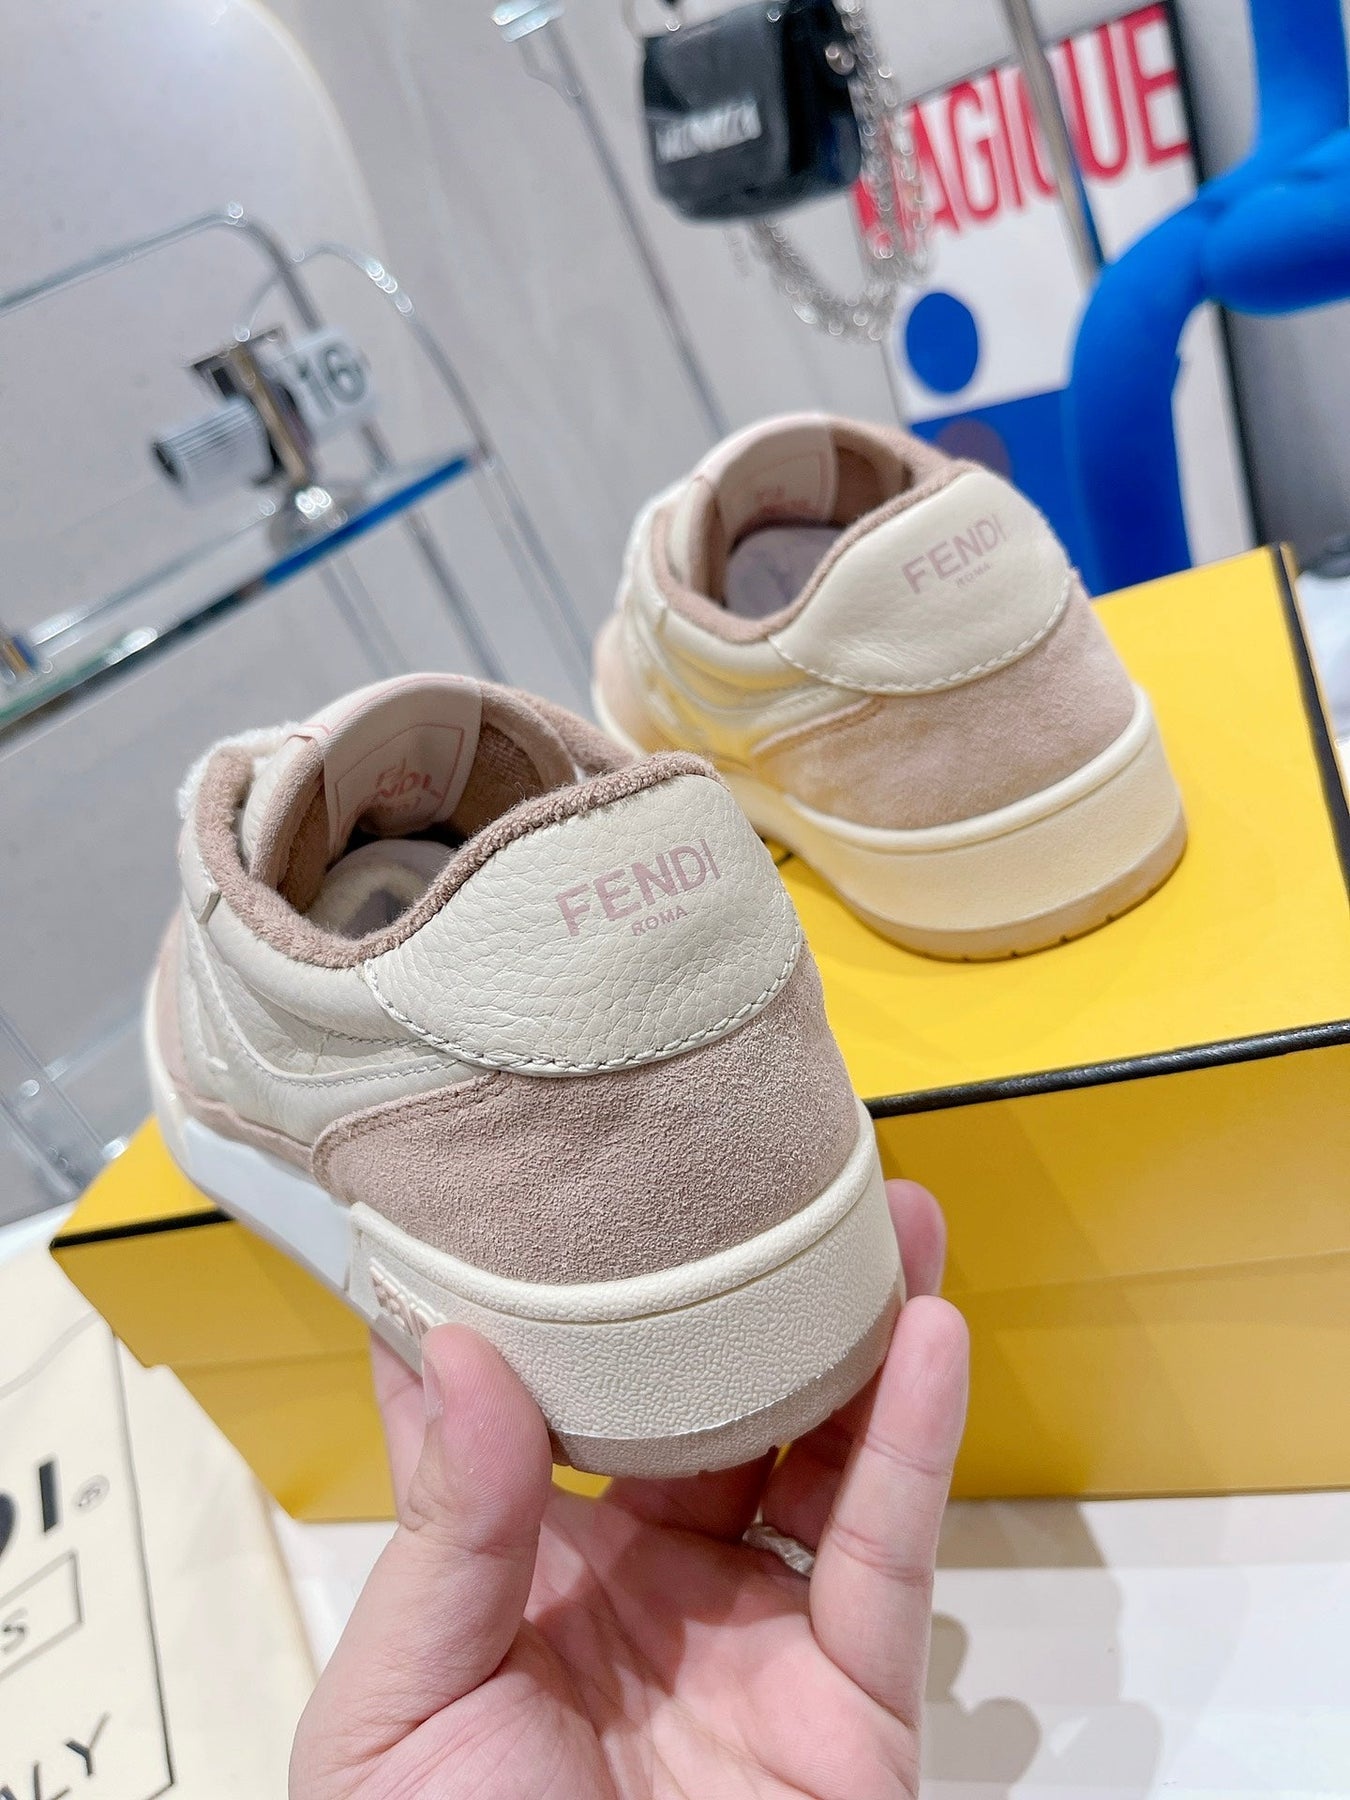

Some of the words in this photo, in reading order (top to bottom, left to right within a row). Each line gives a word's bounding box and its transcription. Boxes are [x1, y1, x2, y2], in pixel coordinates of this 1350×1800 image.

[853, 2, 1192, 258] AGIUE
[290, 341, 367, 417] 16
[902, 512, 1007, 594] FENDI
[555, 838, 721, 937] FENDI
[631, 904, 688, 937] ROMA
